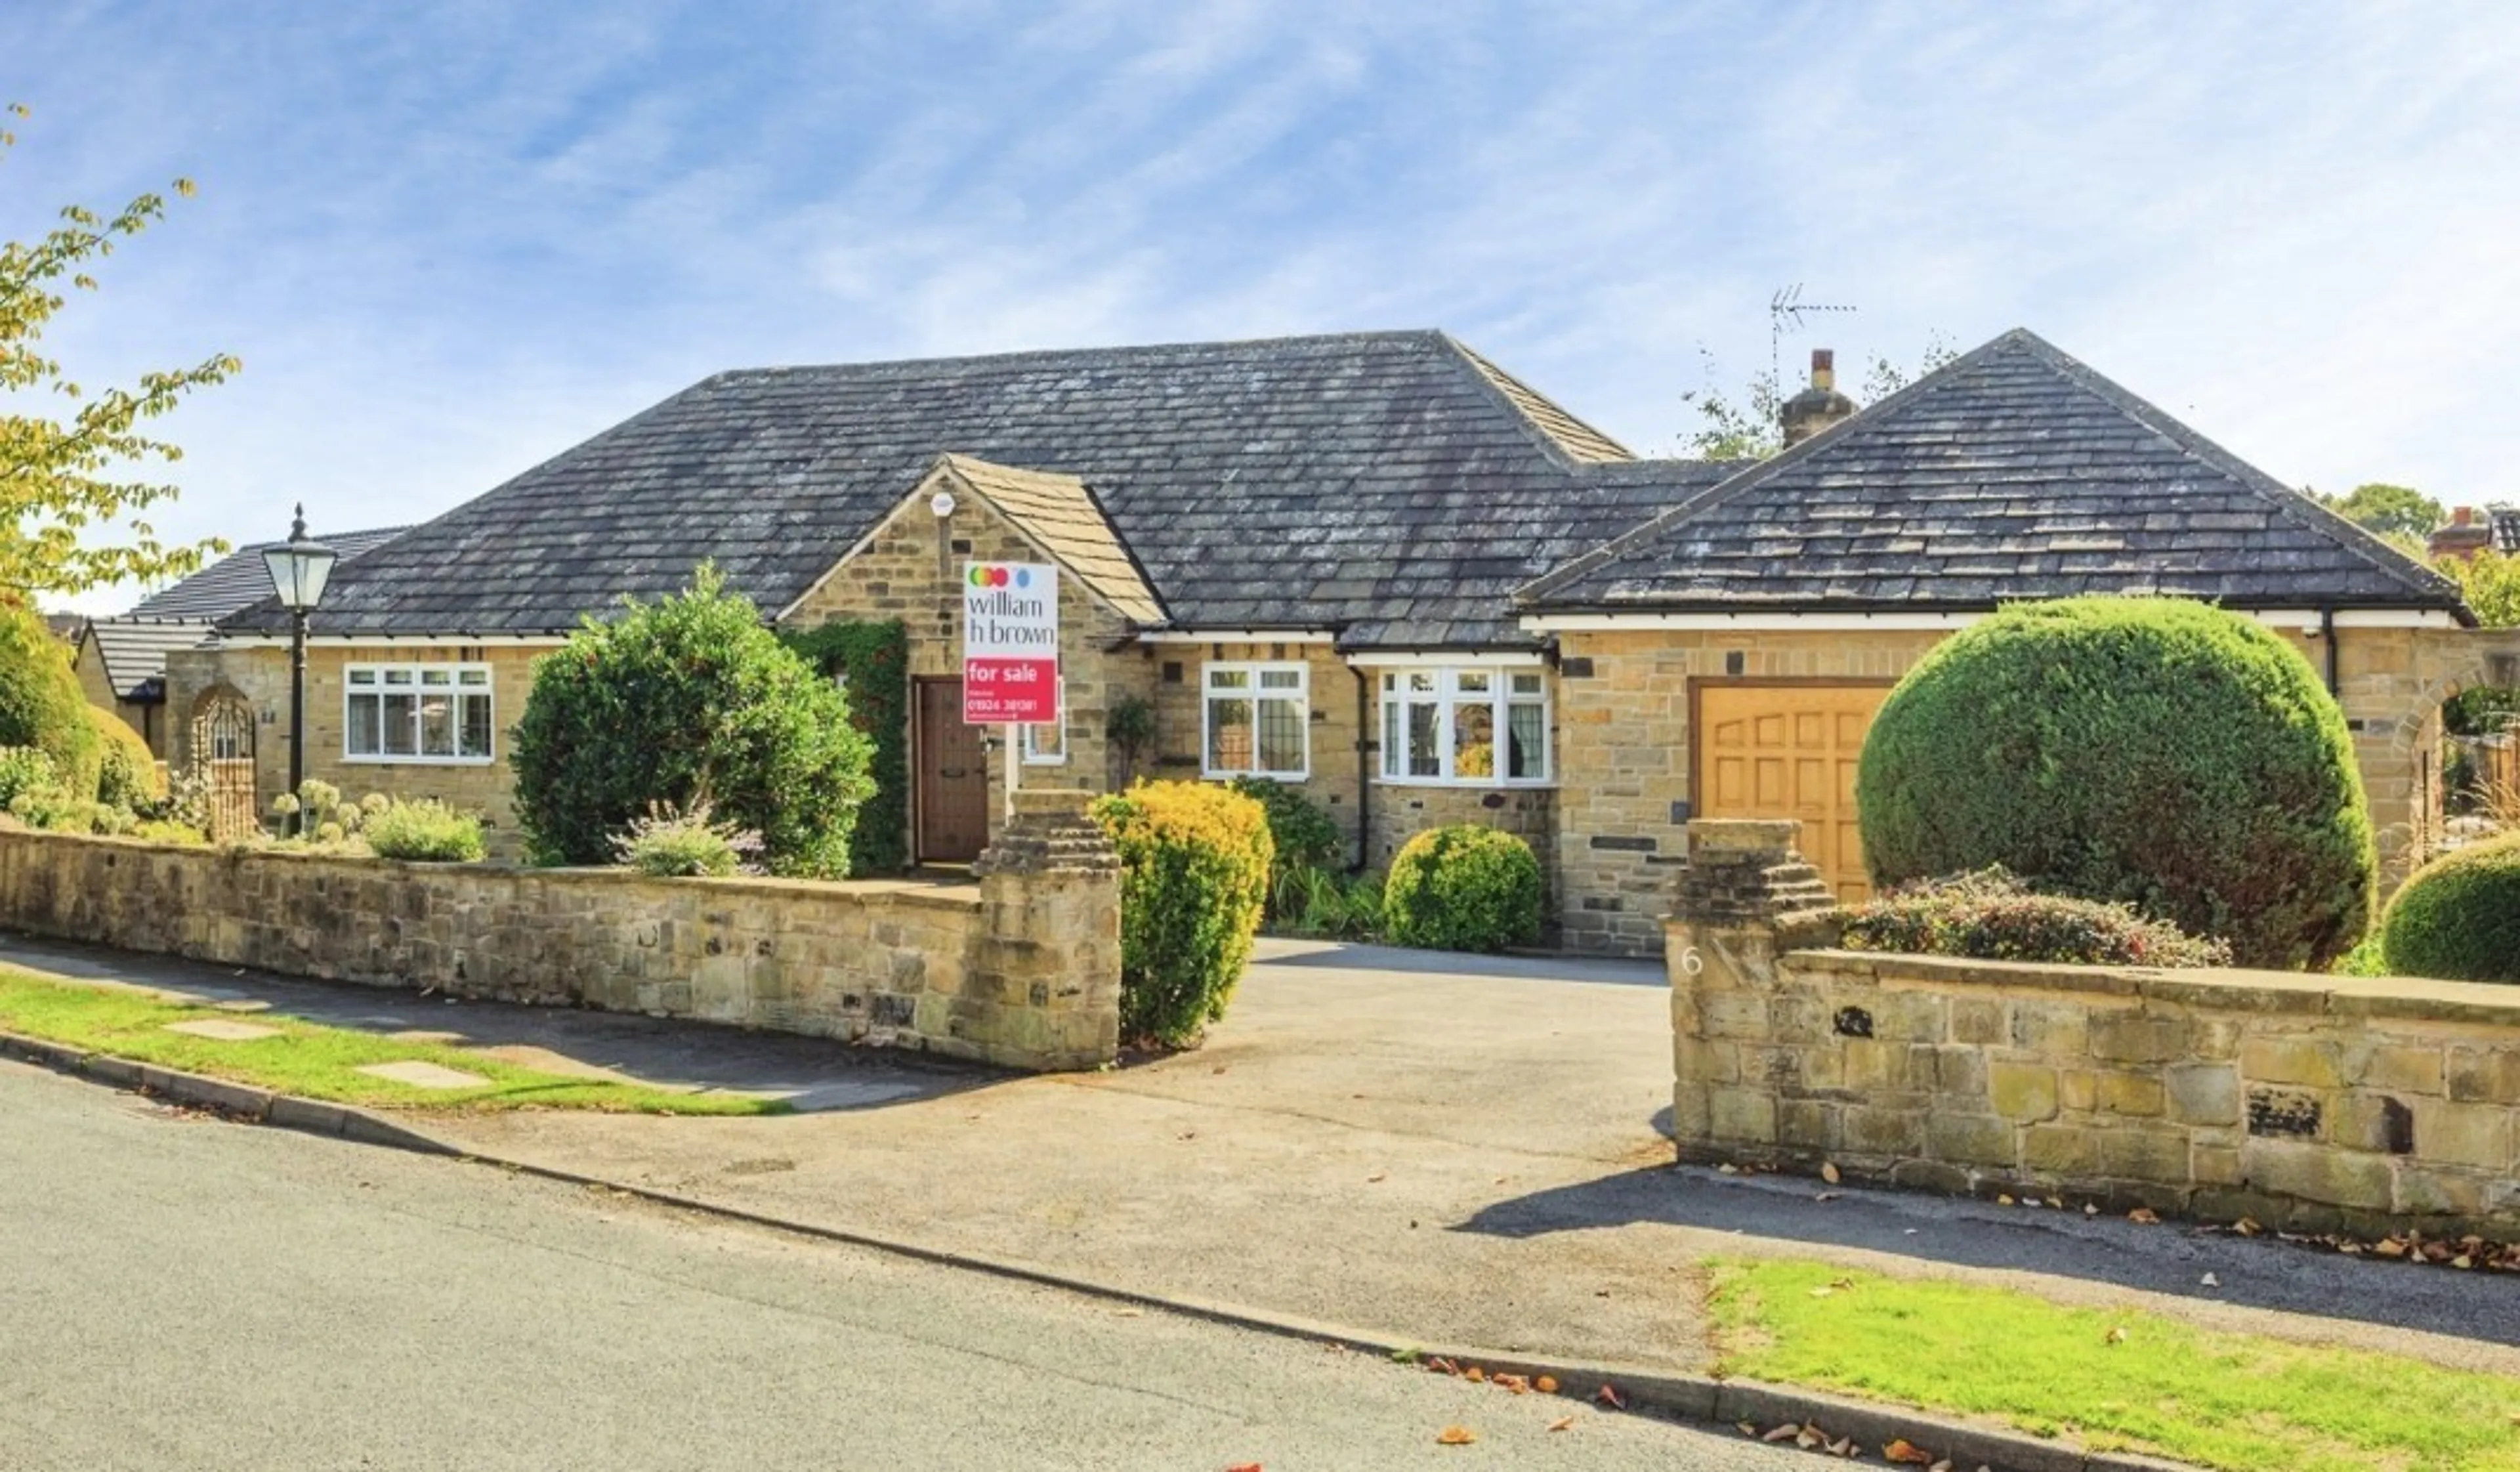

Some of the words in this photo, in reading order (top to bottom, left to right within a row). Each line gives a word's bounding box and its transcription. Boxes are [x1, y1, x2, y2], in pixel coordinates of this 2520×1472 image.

[969, 592, 1042, 617] william
[971, 619, 983, 642] h
[990, 620, 1054, 644] brown
[968, 662, 998, 682] for
[1003, 663, 1038, 681] sale
[1681, 946, 1703, 976] 6
